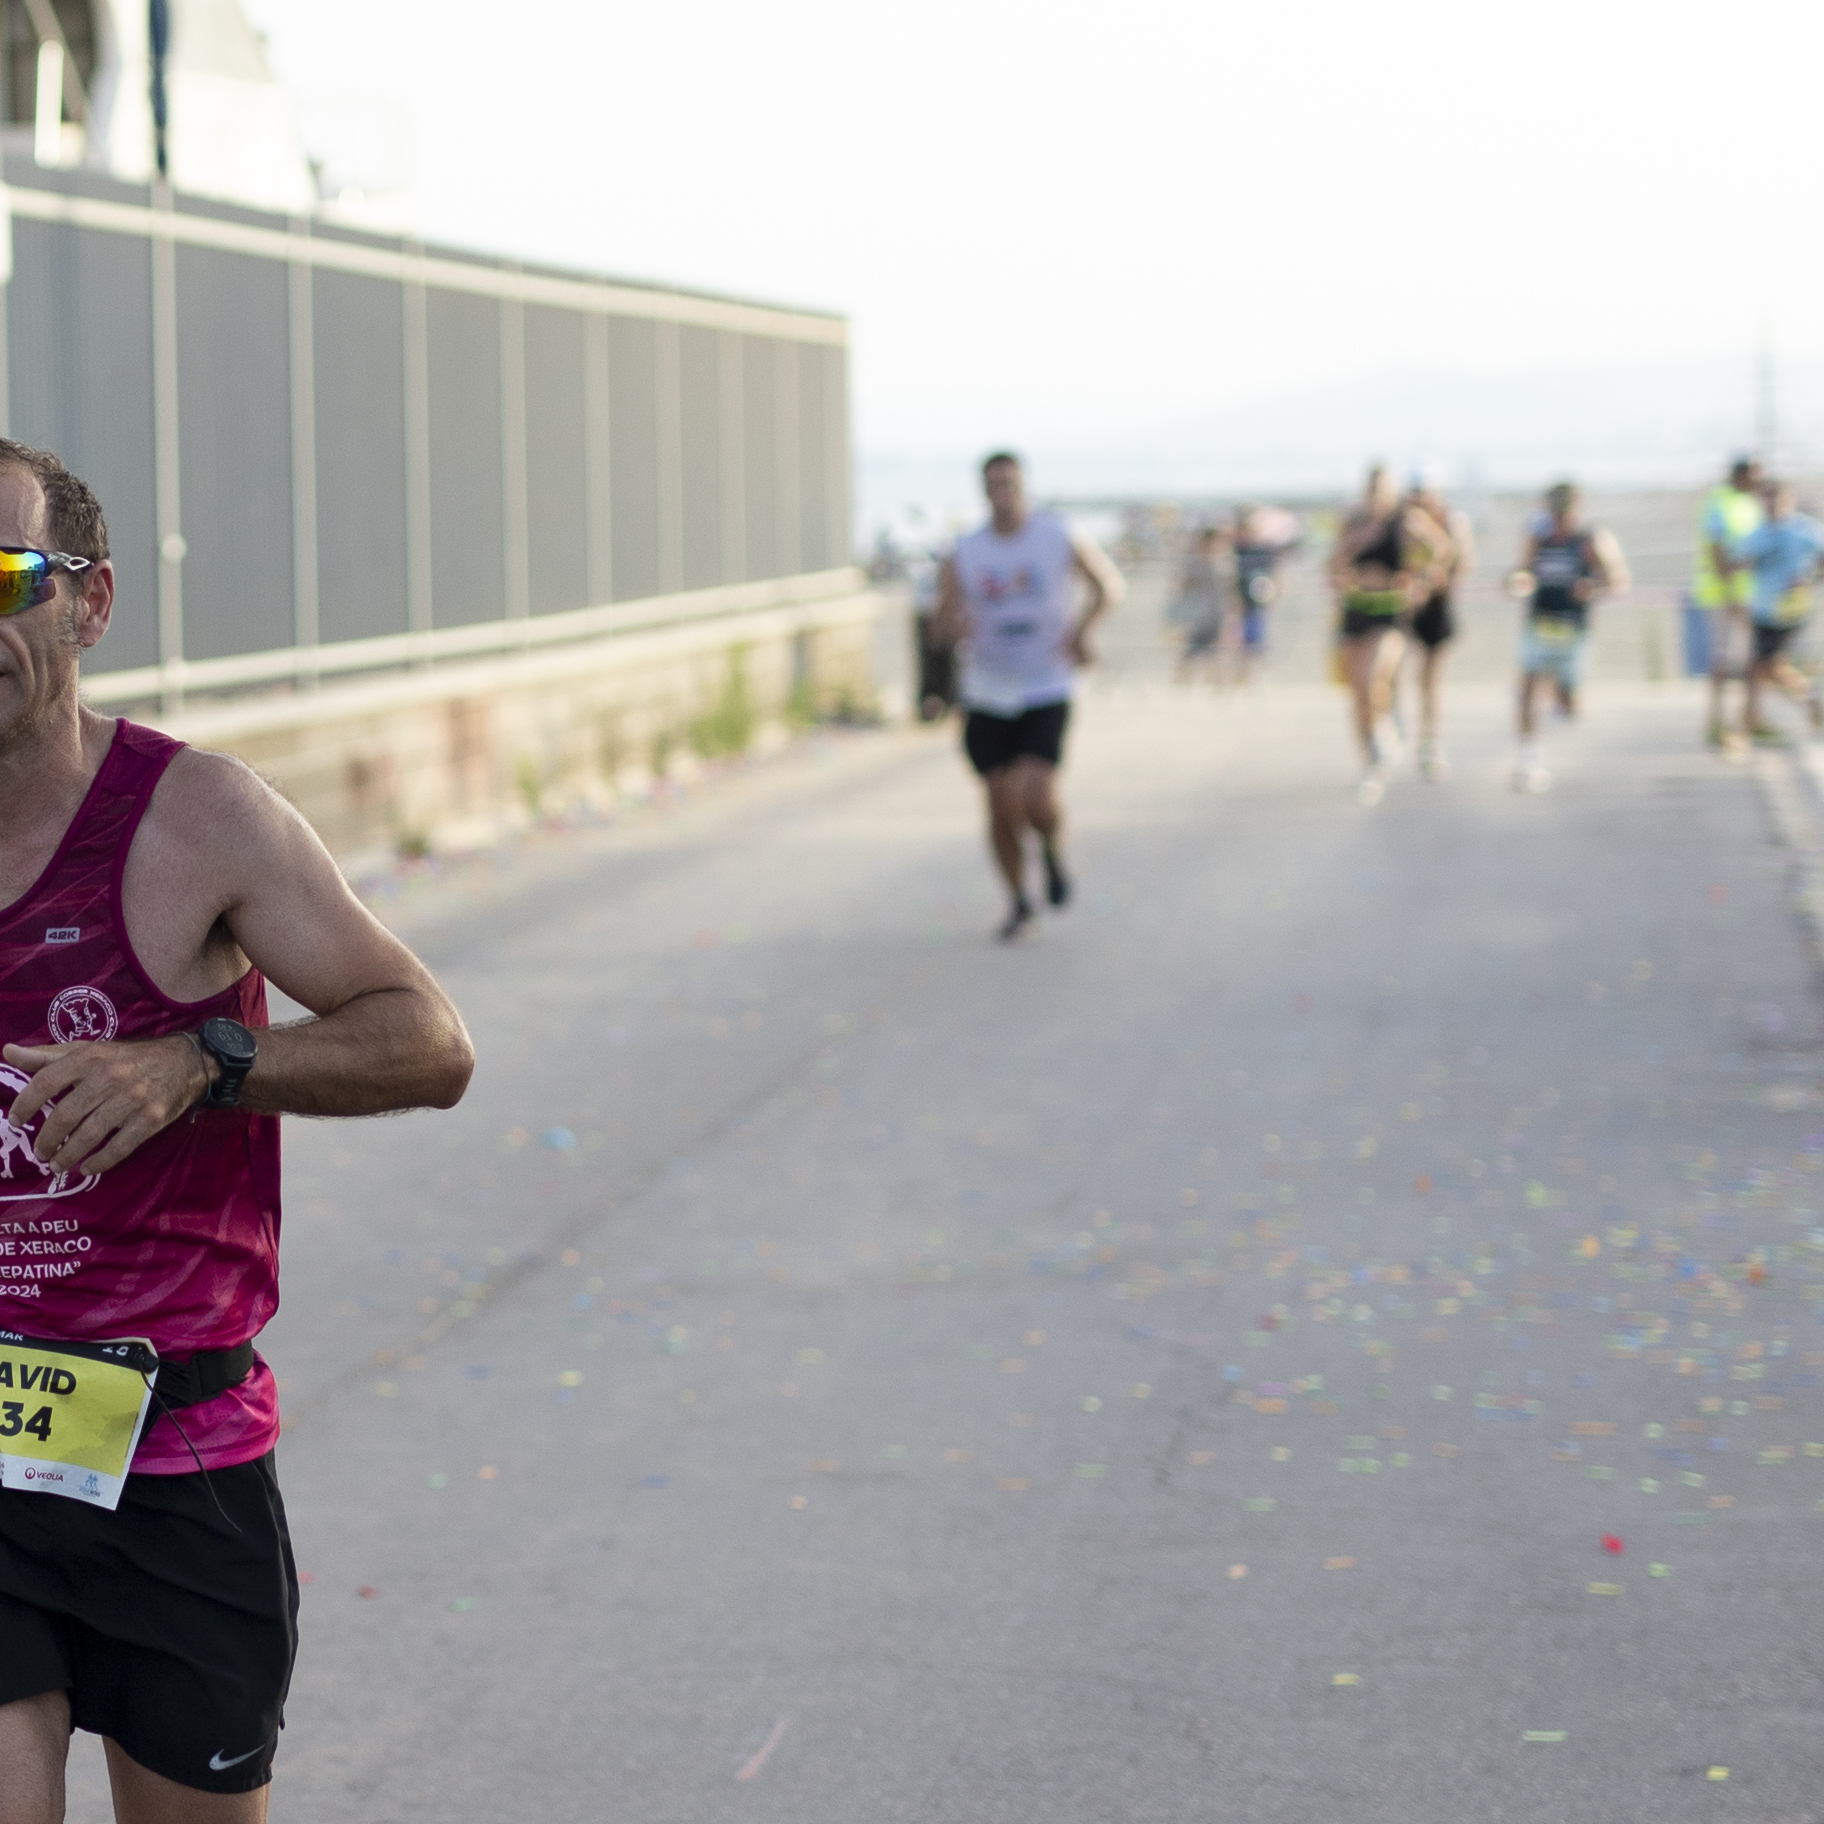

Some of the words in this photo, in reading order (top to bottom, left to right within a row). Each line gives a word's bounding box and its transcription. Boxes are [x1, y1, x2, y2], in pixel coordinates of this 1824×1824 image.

[47, 930, 77, 940] 42K
[28, 1221, 40, 1234] A
[41, 1219, 79, 1234] PEU
[19, 1236, 92, 1256] XERACO
[36, 1471, 64, 1482] VEOLIA
